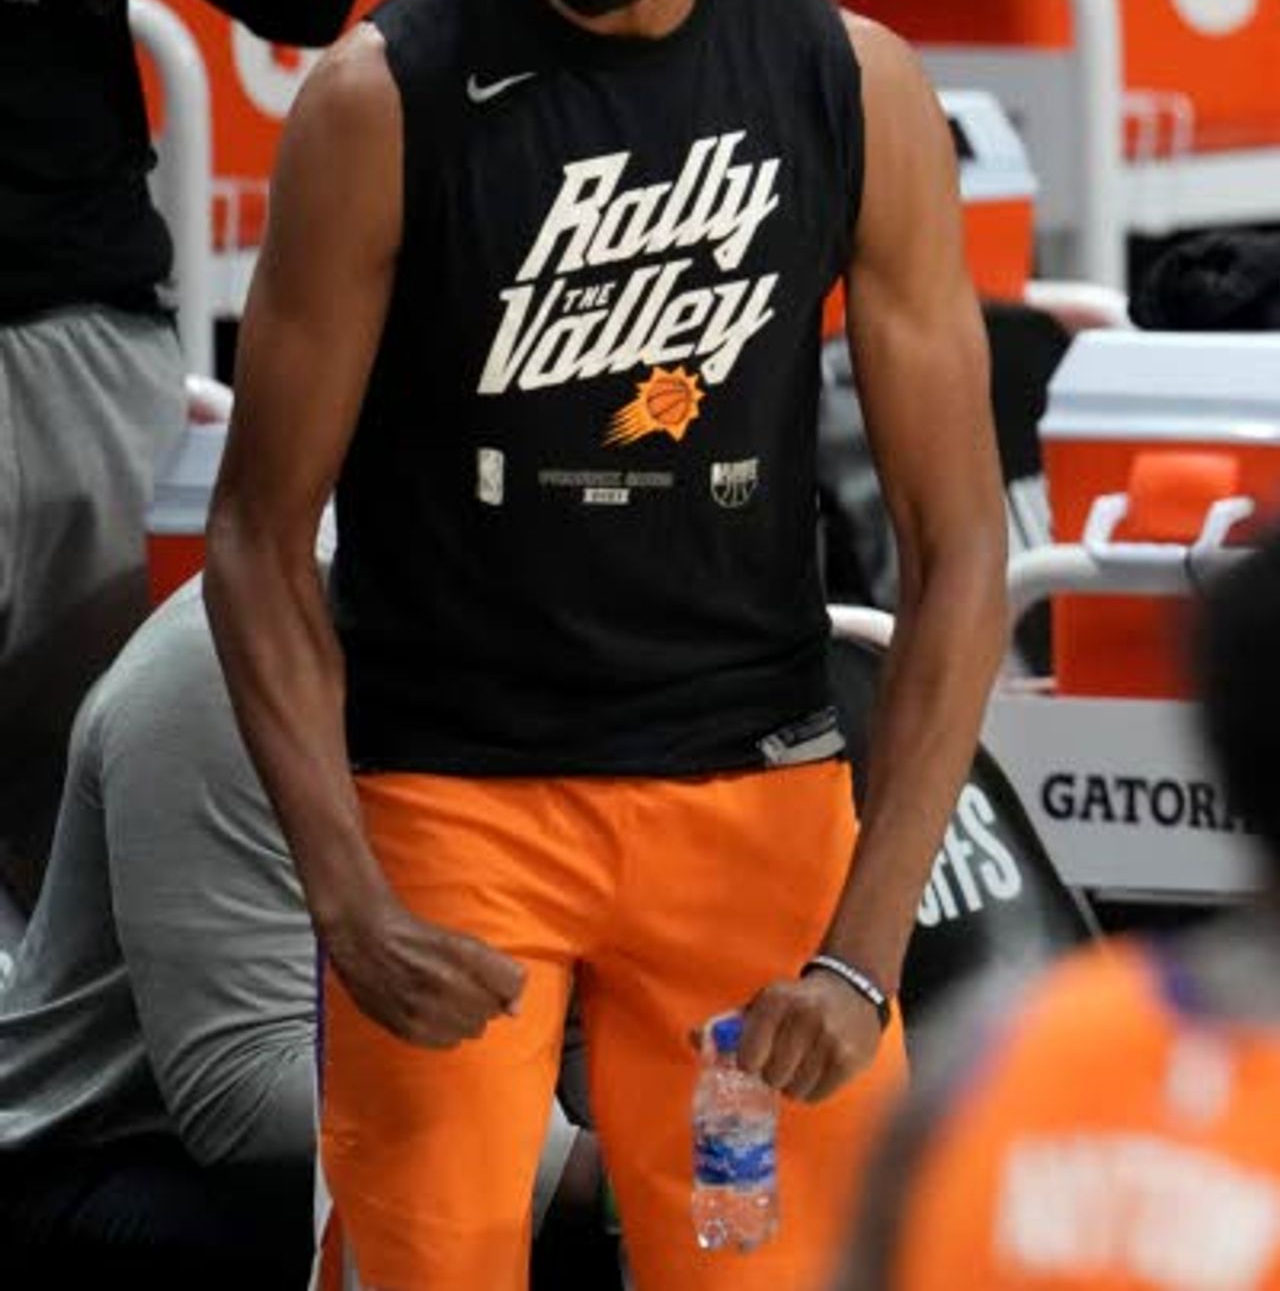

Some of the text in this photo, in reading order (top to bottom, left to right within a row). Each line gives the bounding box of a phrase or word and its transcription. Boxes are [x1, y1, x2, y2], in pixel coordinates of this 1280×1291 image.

[516, 130, 780, 282] Rally
[477, 258, 779, 395] Valley
[562, 282, 616, 312] THE
